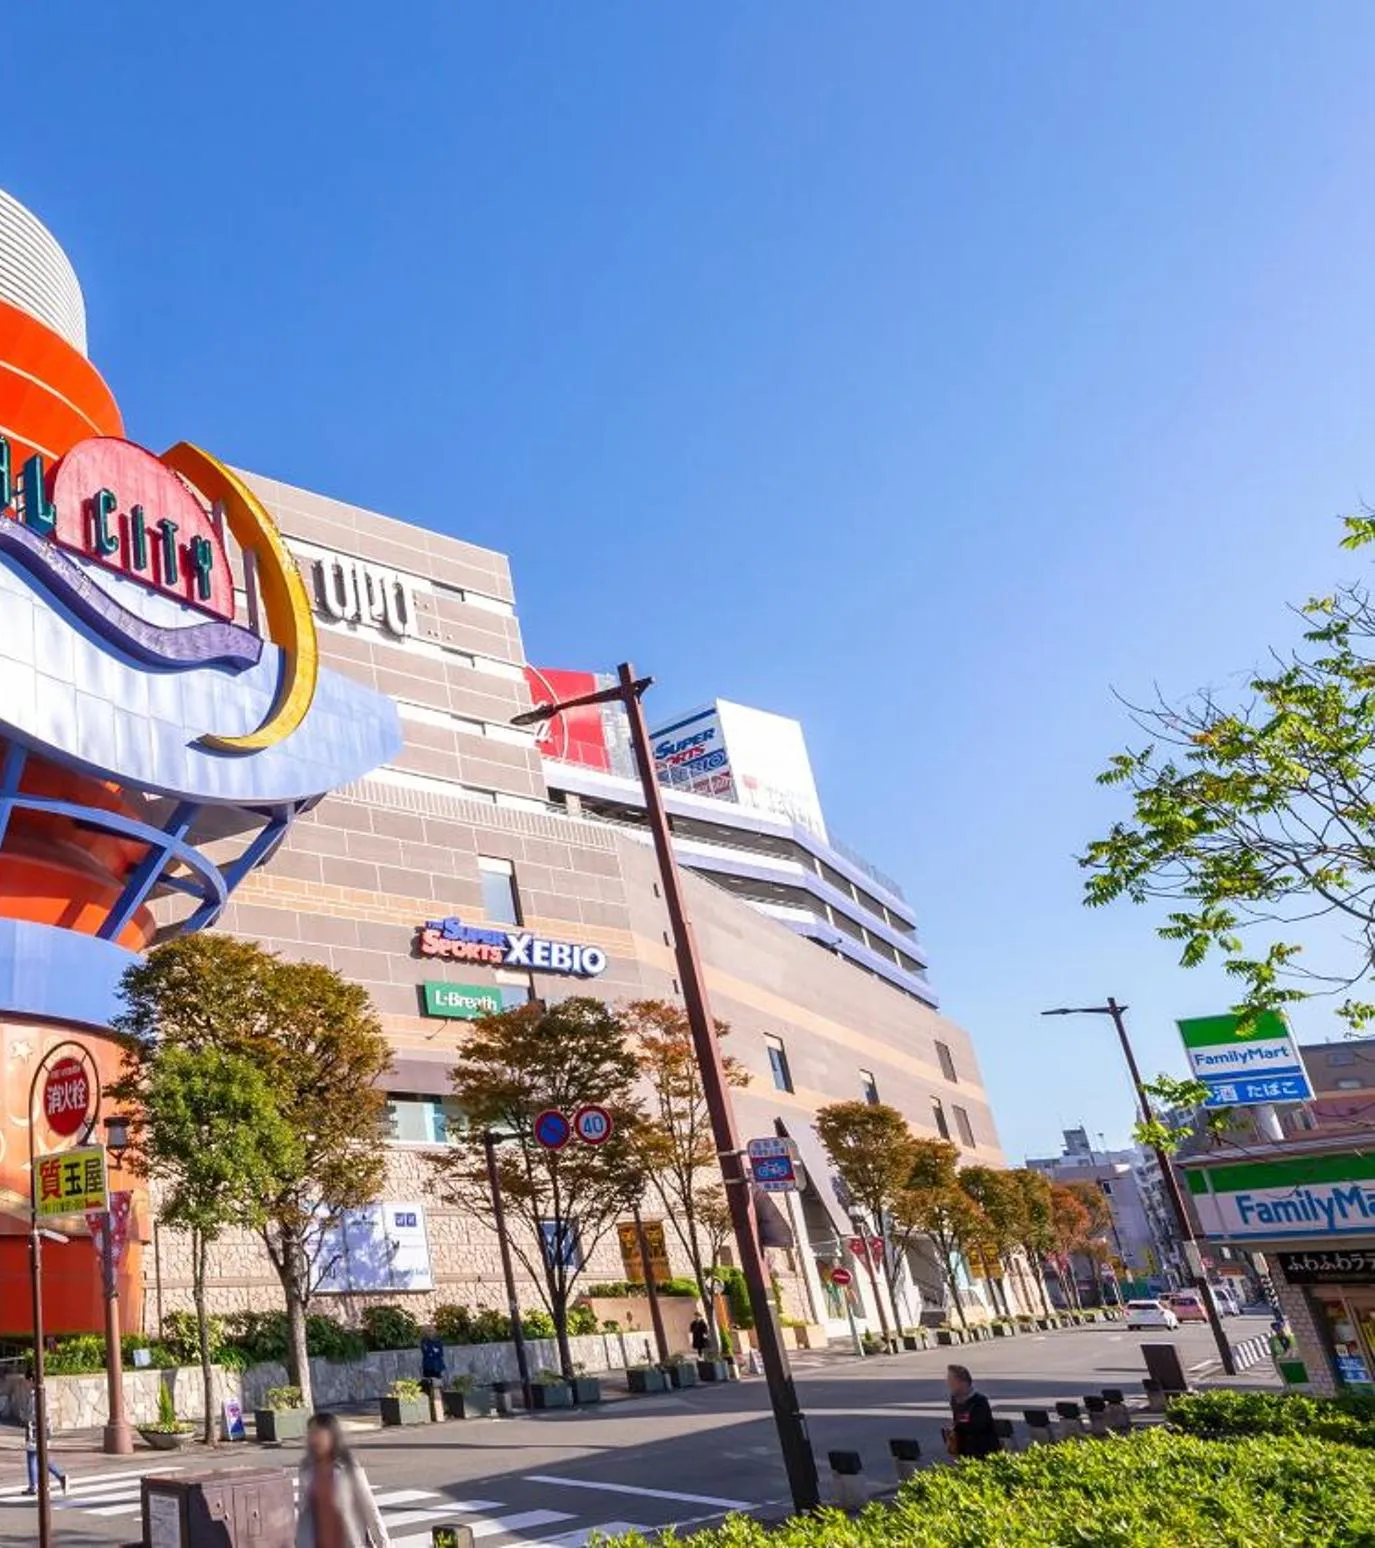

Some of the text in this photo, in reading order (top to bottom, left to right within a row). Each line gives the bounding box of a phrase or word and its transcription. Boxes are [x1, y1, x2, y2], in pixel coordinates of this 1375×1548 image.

[92, 487, 214, 601] CITY
[655, 727, 715, 760] SUPER
[422, 928, 503, 964] SPORTS
[504, 932, 606, 976] XEBIO
[1194, 1046, 1289, 1066] FamilyMart
[47, 1079, 87, 1114] 消火栓
[584, 1116, 604, 1134] 40
